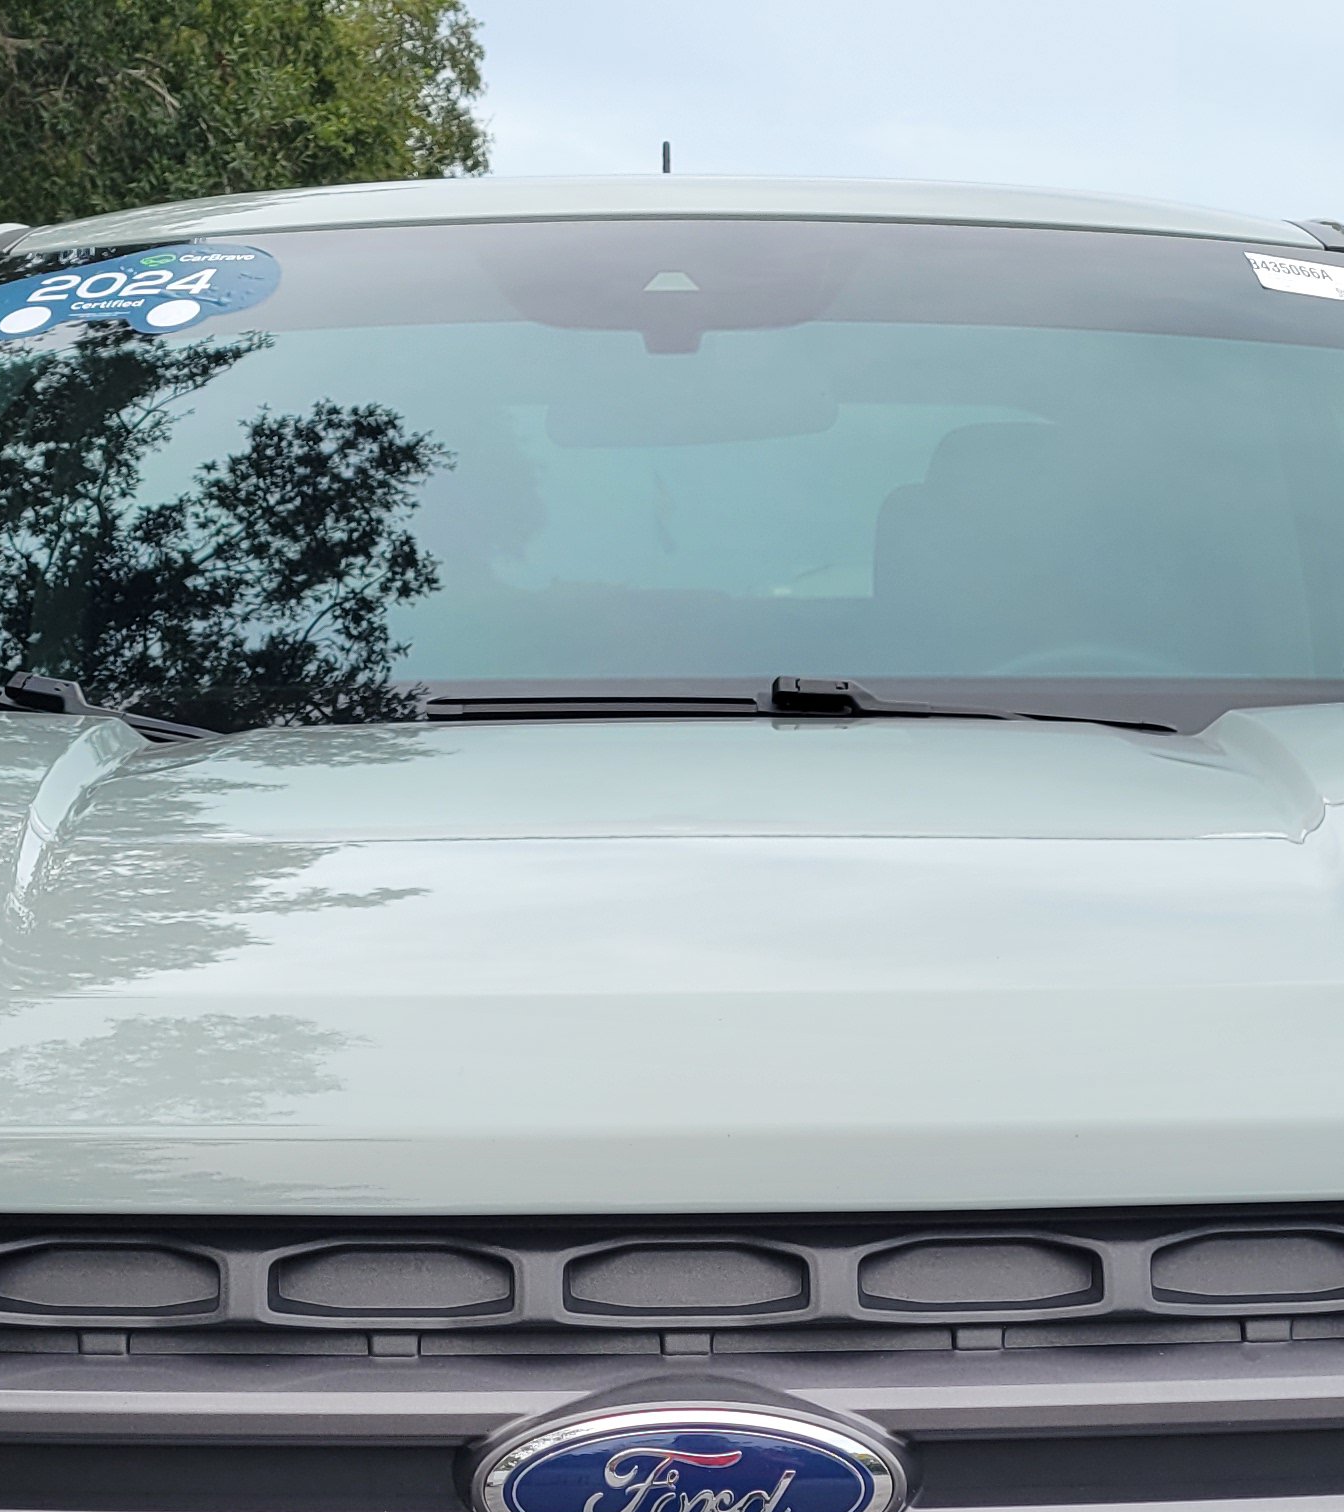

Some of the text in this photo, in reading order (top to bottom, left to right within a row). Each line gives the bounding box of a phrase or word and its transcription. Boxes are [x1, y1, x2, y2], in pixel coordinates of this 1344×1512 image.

[179, 253, 256, 263] CarBravo
[27, 267, 218, 303] 2024
[70, 298, 146, 311] Certified
